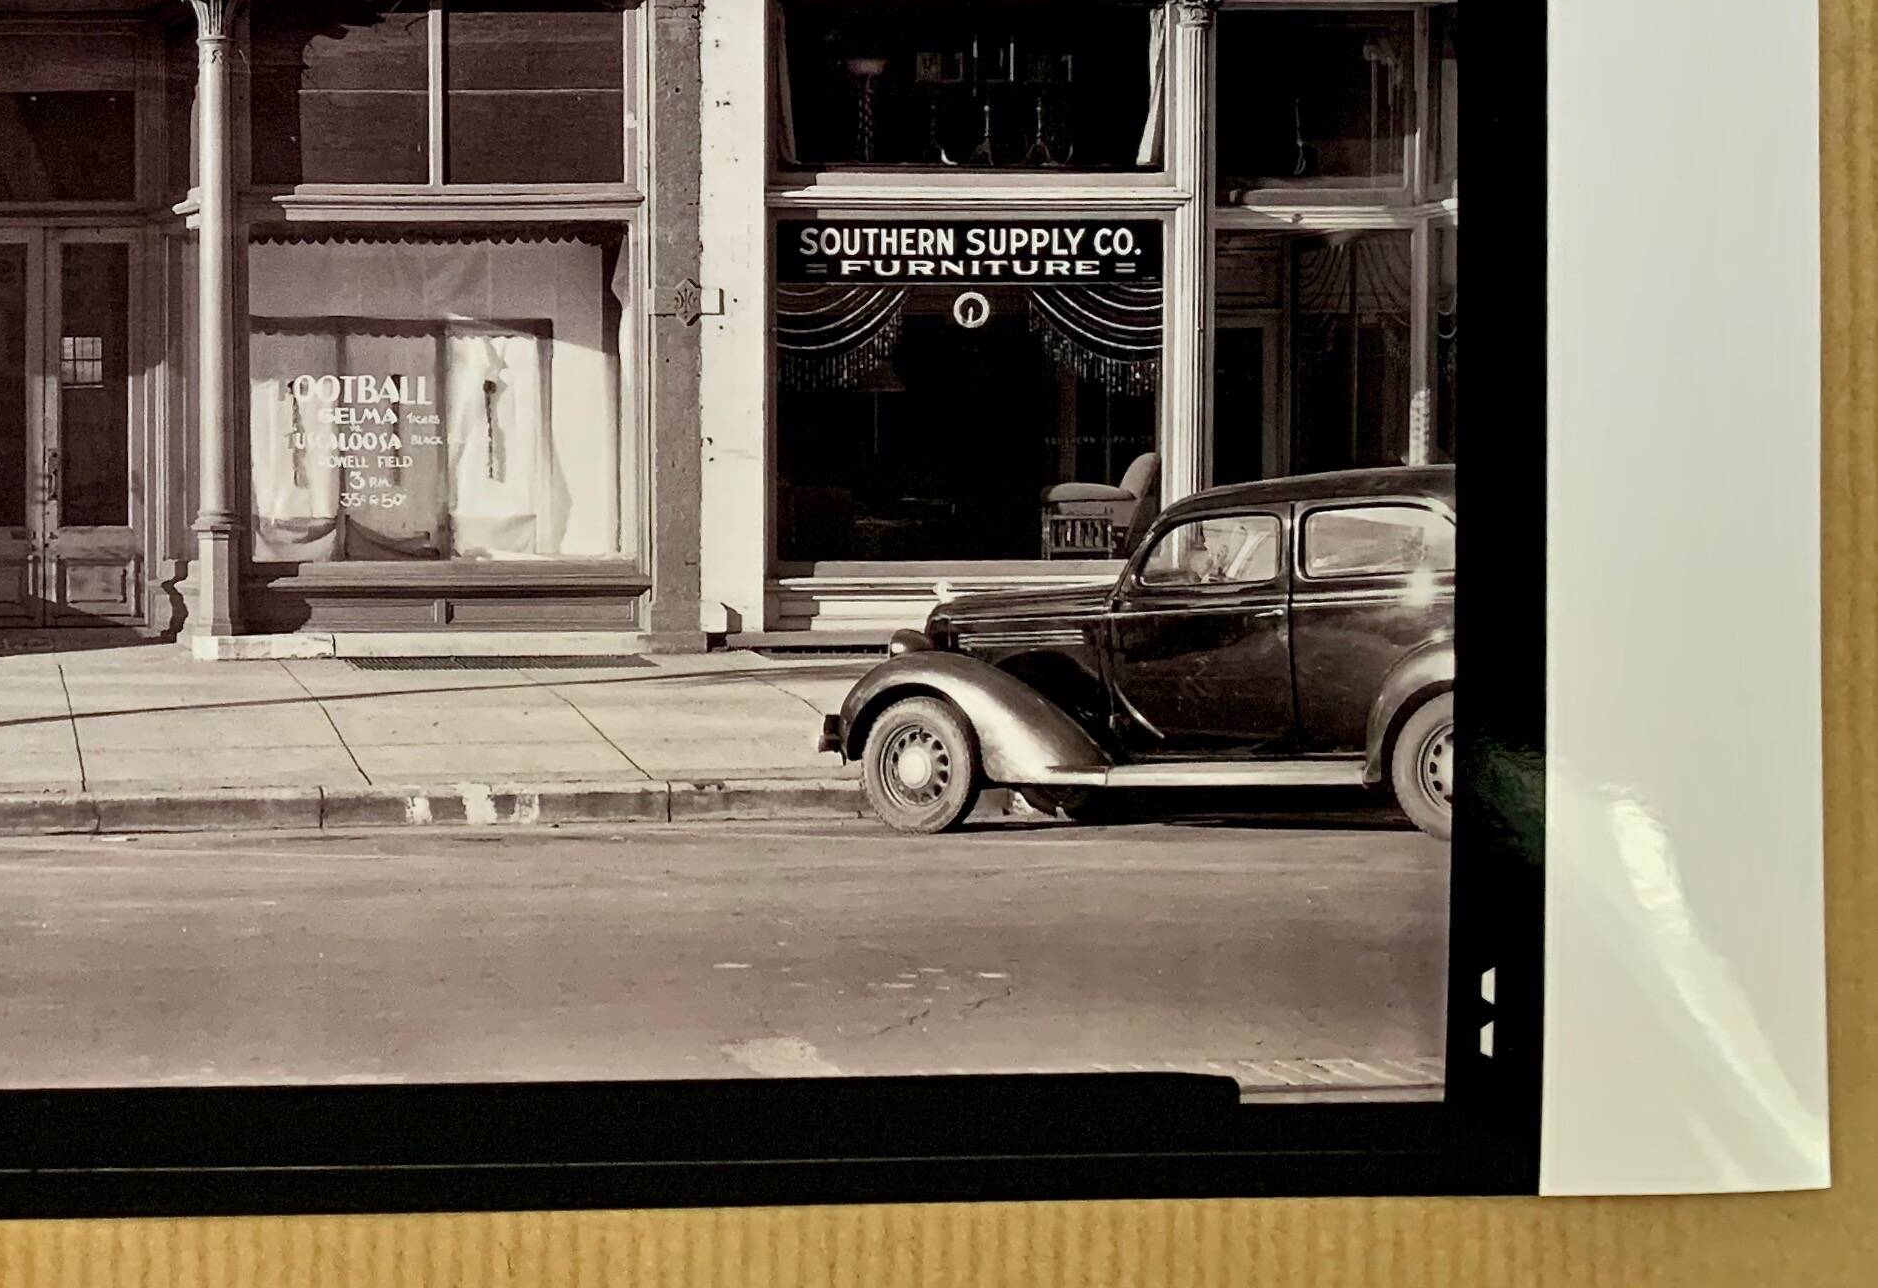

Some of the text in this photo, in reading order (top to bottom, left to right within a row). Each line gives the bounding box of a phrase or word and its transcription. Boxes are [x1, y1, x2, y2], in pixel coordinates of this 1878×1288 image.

[799, 227, 1143, 257] SOUTHERN SUPPLY CO.
[839, 259, 1101, 277] FURNITURE
[317, 407, 398, 425] SELMA
[378, 455, 413, 468] FIELD
[349, 471, 365, 490] 3
